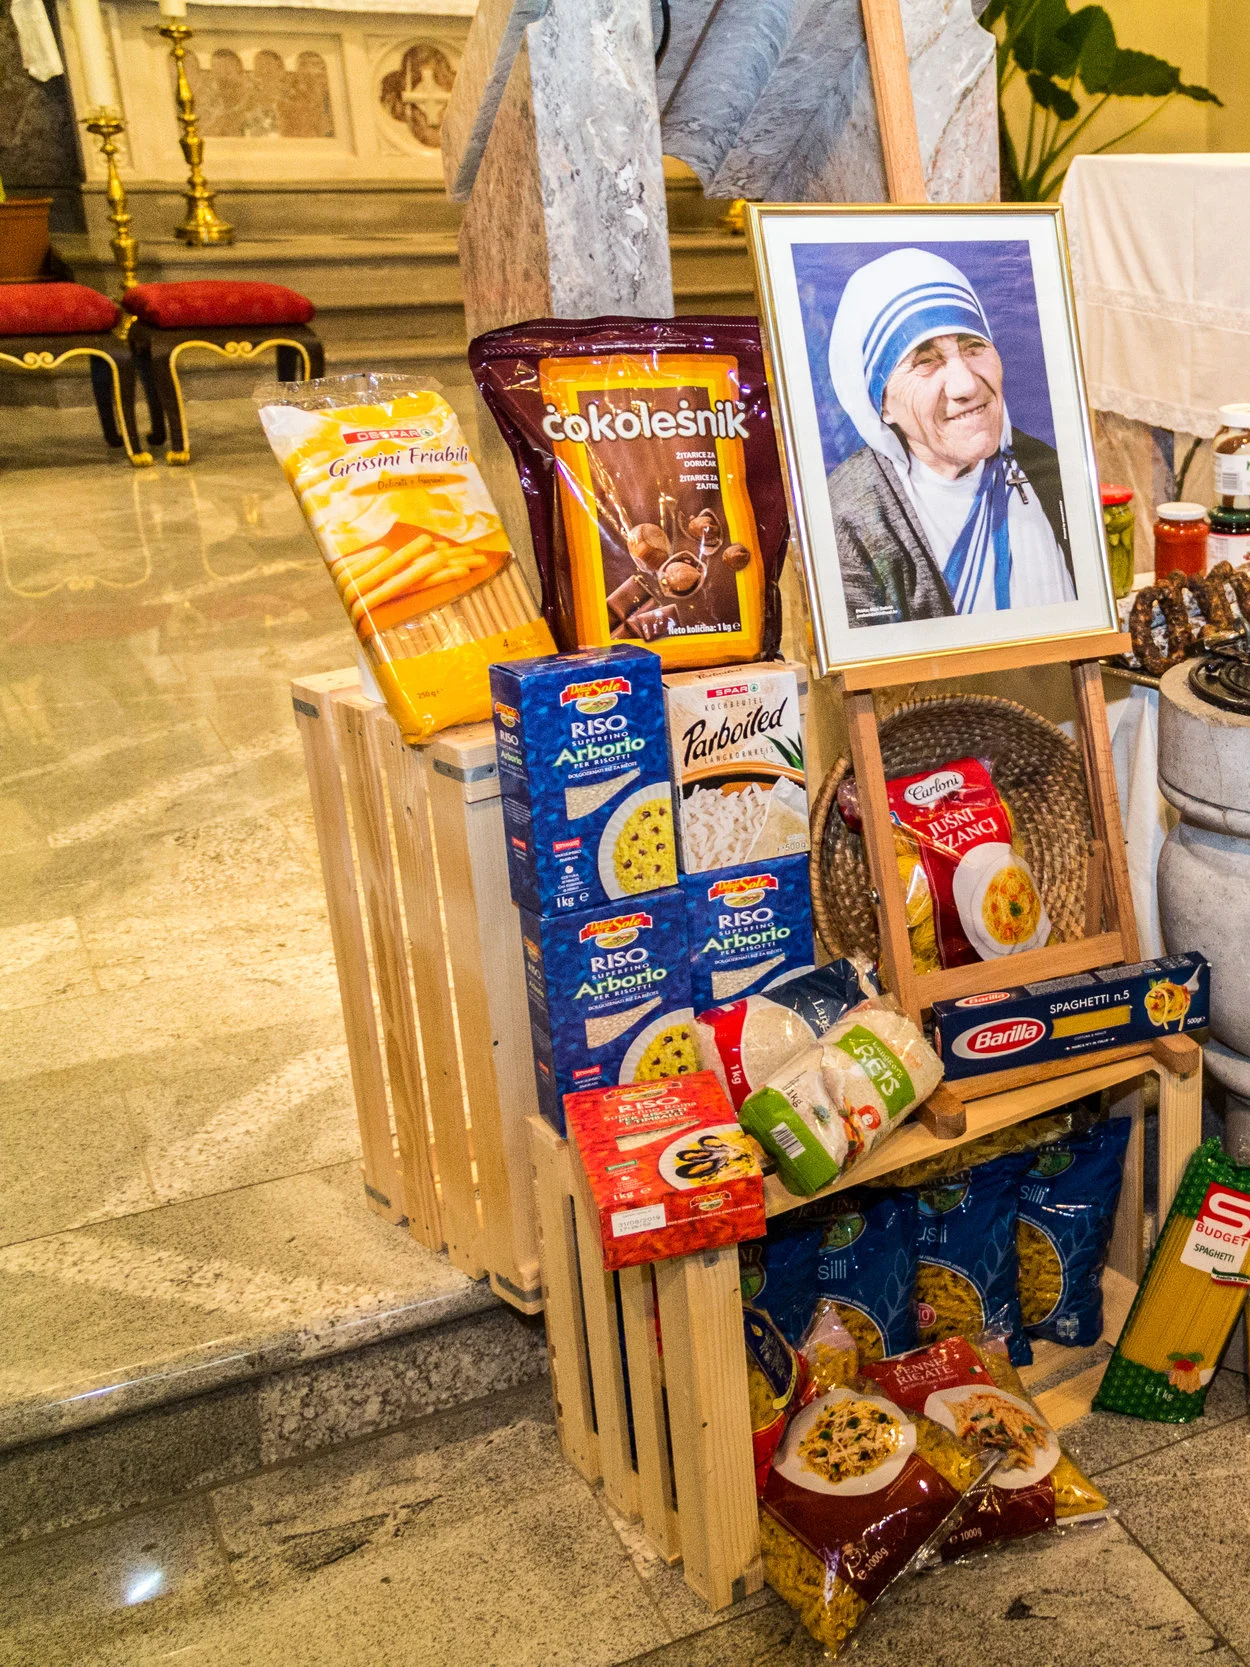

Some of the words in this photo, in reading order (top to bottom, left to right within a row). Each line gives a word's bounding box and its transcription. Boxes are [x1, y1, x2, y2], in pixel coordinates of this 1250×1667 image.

[356, 429, 420, 441] DESPAR
[329, 450, 400, 478] Grissini
[408, 446, 469, 465] Friabili
[675, 451, 706, 460] ŽITARICE
[683, 459, 717, 468] DORUČAK
[679, 474, 706, 482] ŽITARICE
[696, 482, 720, 490] ZAJTRK
[587, 679, 620, 698] Sole
[715, 684, 749, 697] SPAR
[705, 697, 763, 711] KOCHBEUTEL
[571, 715, 628, 738] RISO
[682, 696, 788, 768] Parboiled
[499, 729, 519, 746] RISO
[571, 731, 629, 746] SUPERFINO
[552, 736, 646, 767] Arborio
[573, 759, 590, 769] PER
[594, 753, 631, 766] RISOTTI
[704, 746, 774, 764] LANGKORNREIS
[908, 774, 960, 801] Carloni
[927, 807, 976, 839] JUŠNI
[718, 907, 774, 929] RISO
[718, 922, 775, 936] SUPERFINO
[700, 927, 791, 954] Arborio
[720, 948, 736, 956] PER
[740, 941, 776, 952] RISOTTI
[590, 948, 649, 973] RISO
[591, 962, 650, 980] SUPERFINO
[573, 967, 668, 1000] Arborio
[593, 993, 611, 1002] PER
[614, 983, 652, 996] RISOTTI
[969, 993, 1005, 1004] Barilla
[1049, 994, 1110, 1014] SPAGHETTI
[1113, 989, 1130, 1002] n.5
[974, 1023, 1038, 1050] Barilla
[853, 1042, 900, 1098] REIS
[618, 1097, 680, 1113] RISO
[1195, 1222, 1249, 1247] BUDGET
[1193, 1242, 1236, 1263] SPAGHETTI
[893, 1358, 944, 1377] PENNE
[896, 1364, 953, 1386] RIGATE
[960, 1527, 983, 1542] 1000g
[864, 1547, 889, 1572] 1000g
